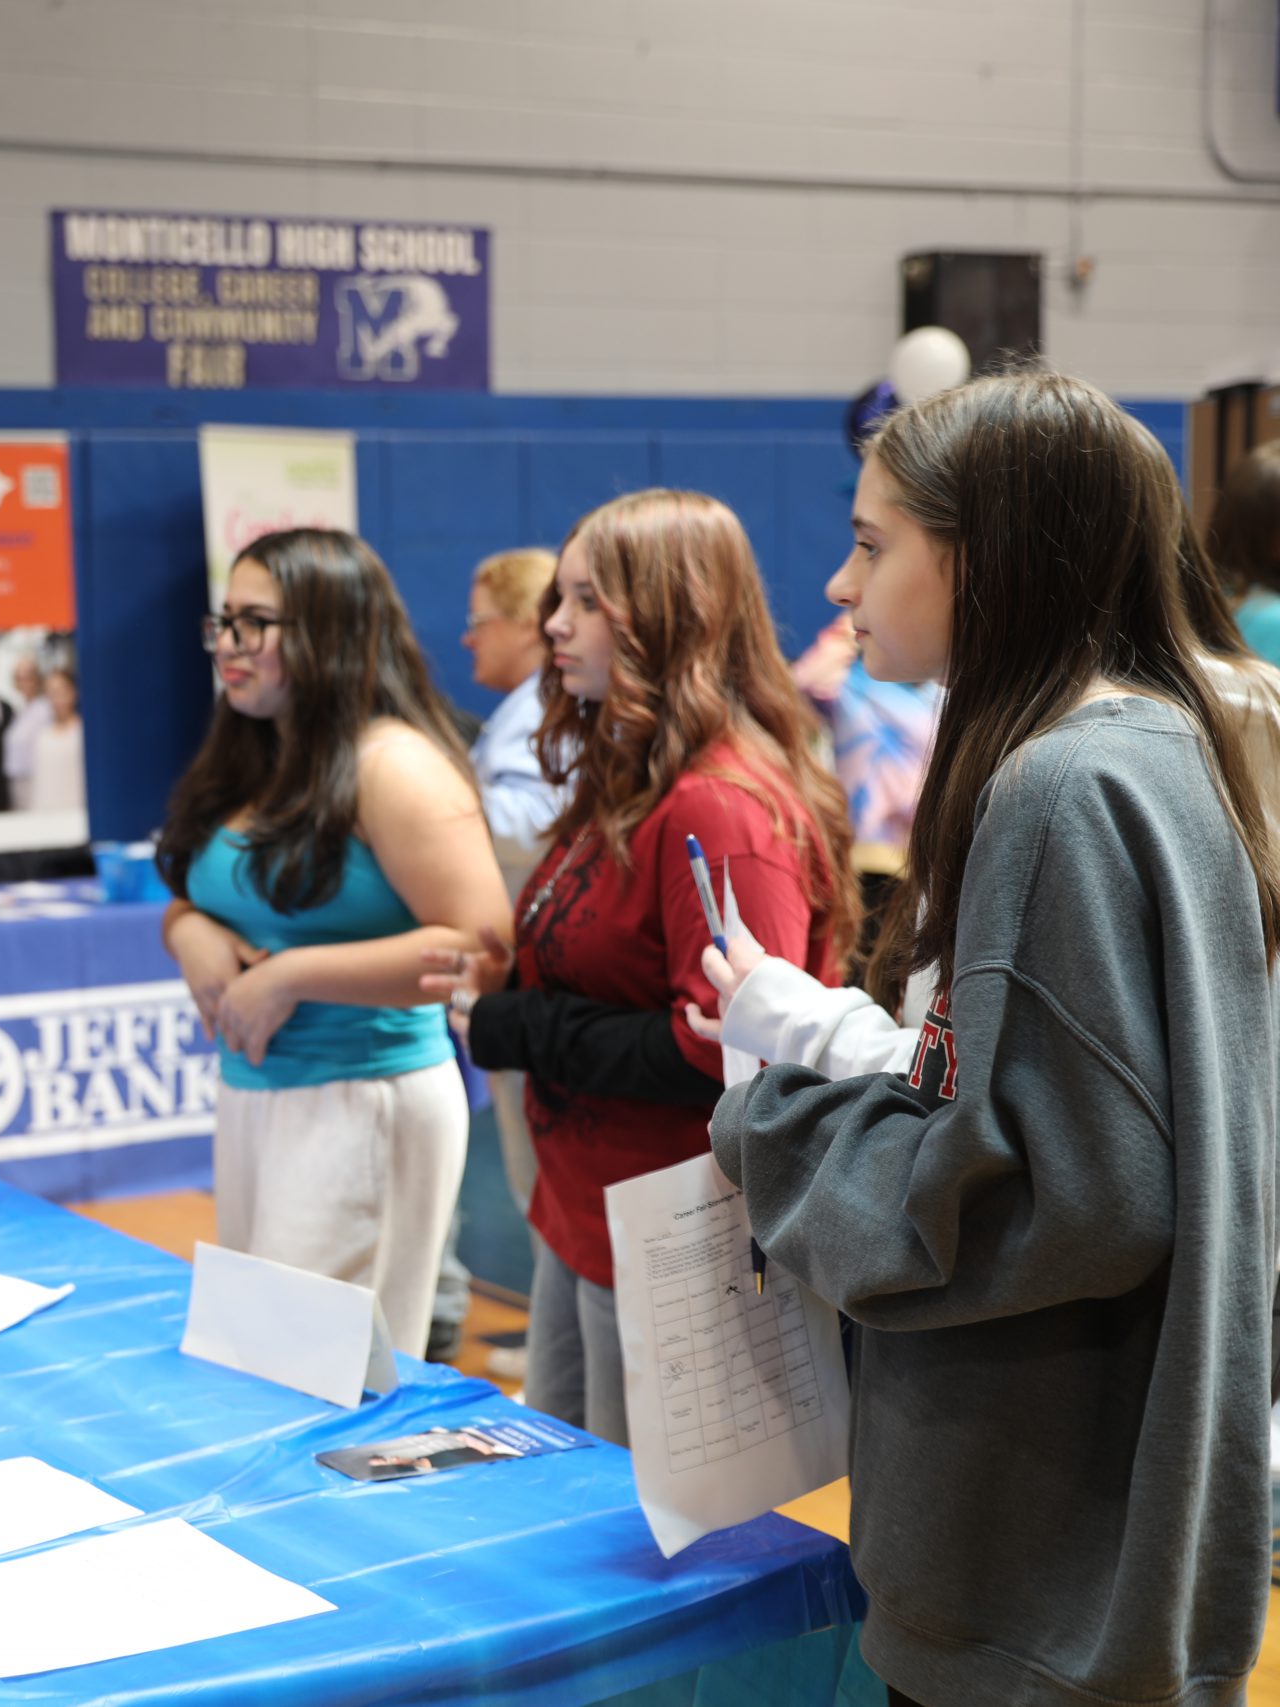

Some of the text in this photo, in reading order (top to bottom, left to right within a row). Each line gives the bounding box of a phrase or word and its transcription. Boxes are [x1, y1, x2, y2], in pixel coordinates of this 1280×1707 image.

[65, 216, 481, 276] MONTICELLO HIGH SCHOOL
[216, 271, 319, 305] CAREER
[86, 304, 318, 345] AND COMMUNITY
[167, 341, 247, 389] FAIR
[25, 1004, 195, 1070] JEFF
[28, 1053, 219, 1131] BANK
